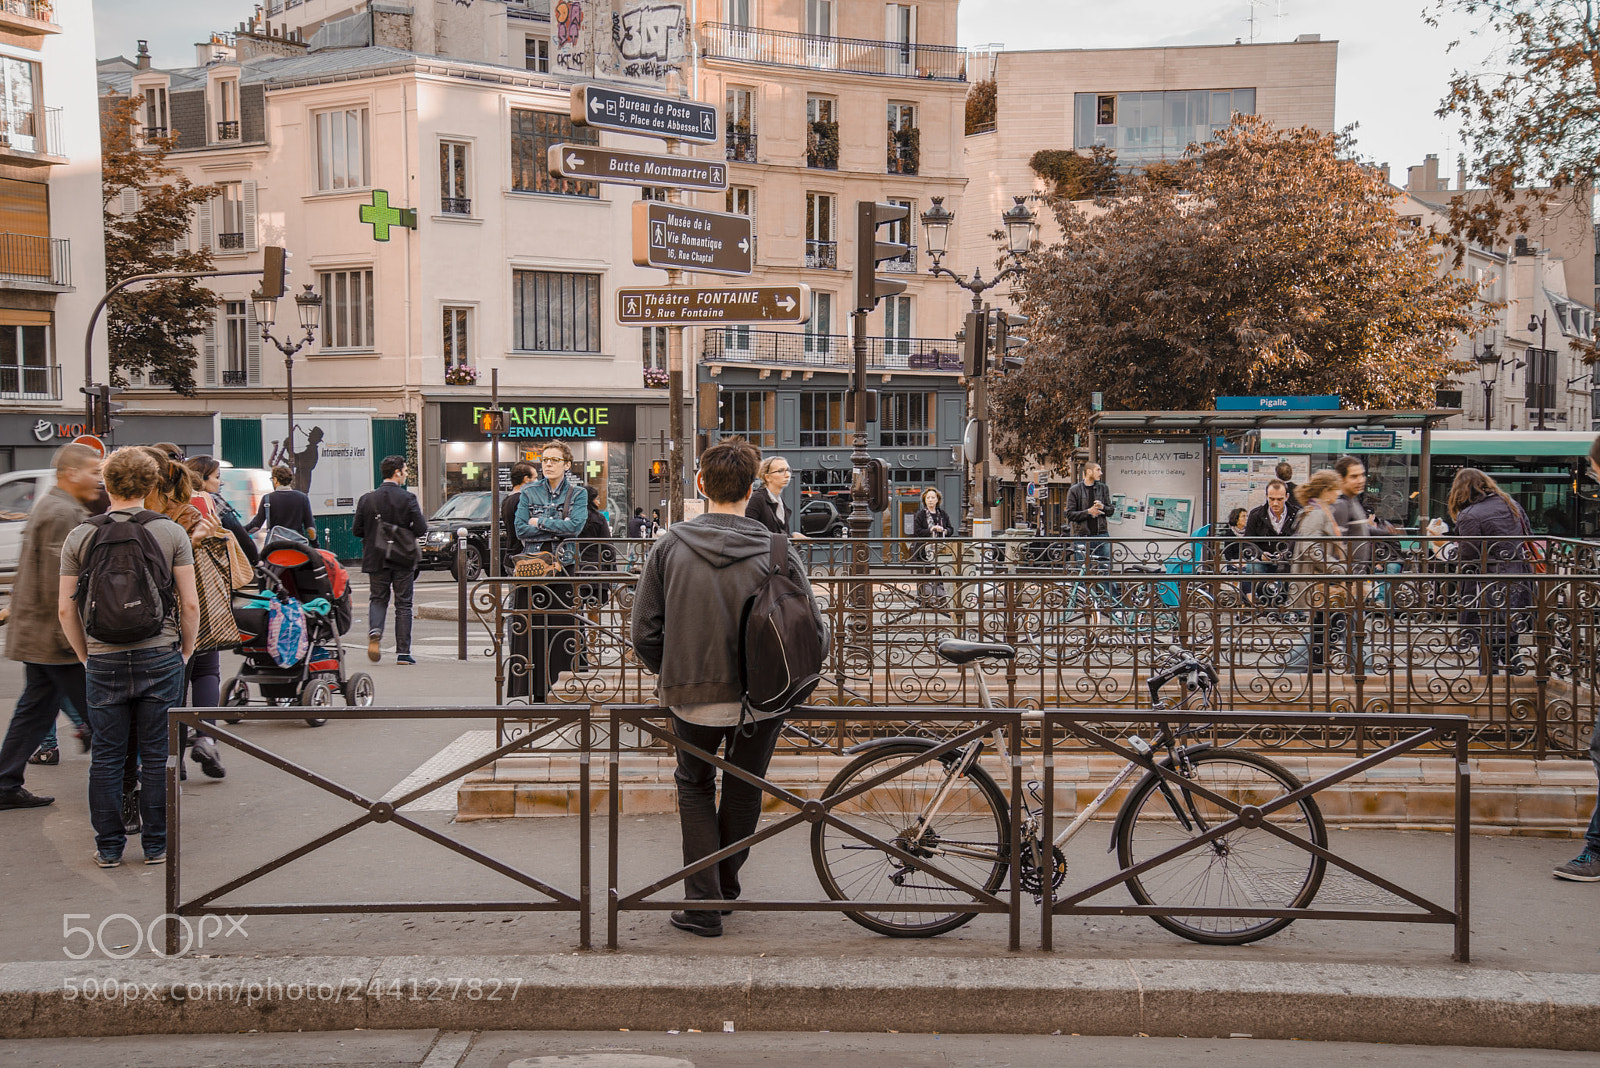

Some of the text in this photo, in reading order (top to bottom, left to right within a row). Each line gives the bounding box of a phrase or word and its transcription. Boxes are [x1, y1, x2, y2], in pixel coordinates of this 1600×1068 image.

[618, 96, 691, 119] Bureau de Poste
[619, 112, 699, 133] 5, Place des Abbesses
[609, 158, 707, 180] Butte Montmartre
[667, 213, 711, 231] Musée de la
[667, 230, 722, 250] Vie Romantique
[667, 248, 714, 264] 16, Rue Chaptal
[645, 291, 759, 305] Théâtre FONTAINE
[644, 307, 724, 319] 9, Rue Fontaine
[1260, 398, 1287, 408] Pigalle
[473, 407, 609, 425] PARMACIE
[486, 427, 596, 437] ERNATIONALE
[353, 447, 365, 457] Vent
[1107, 454, 1134, 462] Samsung
[1135, 452, 1171, 461] GALAXY
